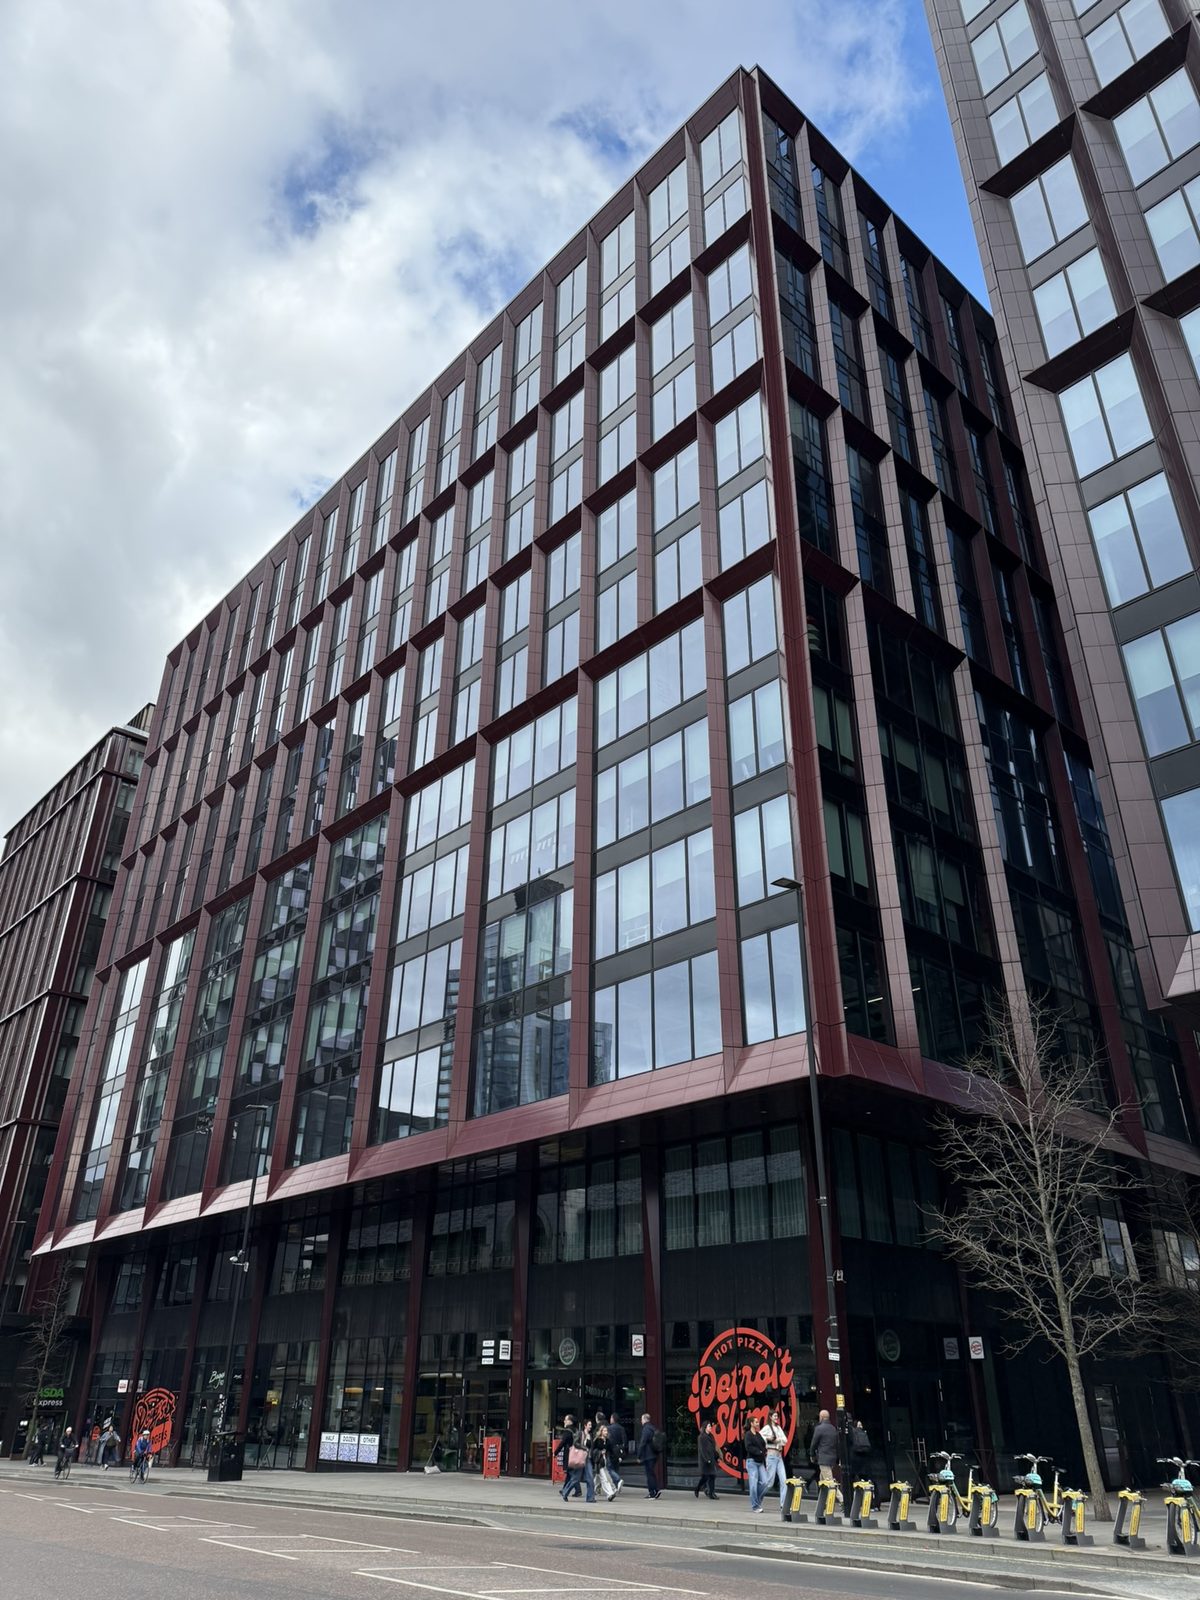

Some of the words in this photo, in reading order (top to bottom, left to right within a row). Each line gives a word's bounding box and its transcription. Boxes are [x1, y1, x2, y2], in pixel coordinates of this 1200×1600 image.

[714, 1338, 734, 1361] HOT
[737, 1337, 769, 1360] PIZZA
[688, 1348, 795, 1413] Detroit
